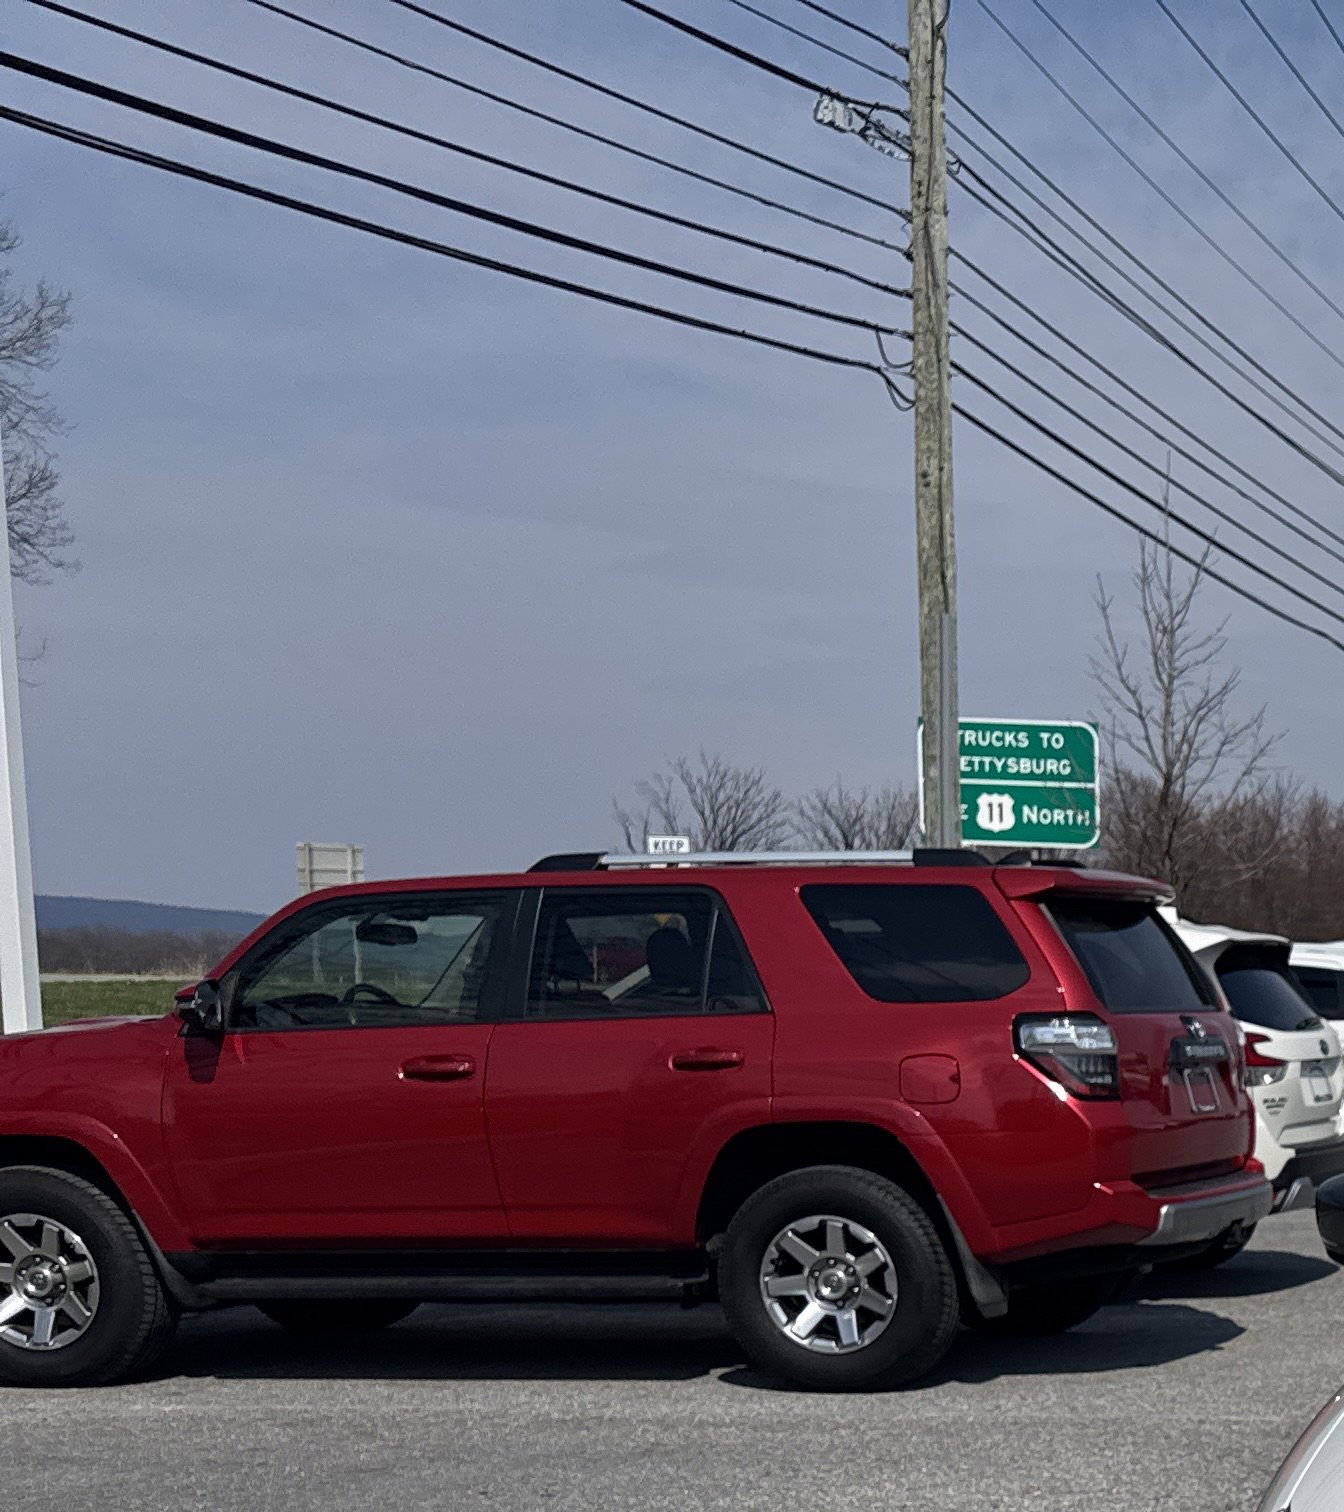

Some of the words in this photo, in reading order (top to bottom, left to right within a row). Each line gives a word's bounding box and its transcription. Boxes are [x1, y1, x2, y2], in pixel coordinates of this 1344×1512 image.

[1039, 732, 1065, 750] TO
[960, 755, 1072, 775] ETTYSBURG
[987, 802, 1003, 823] 11
